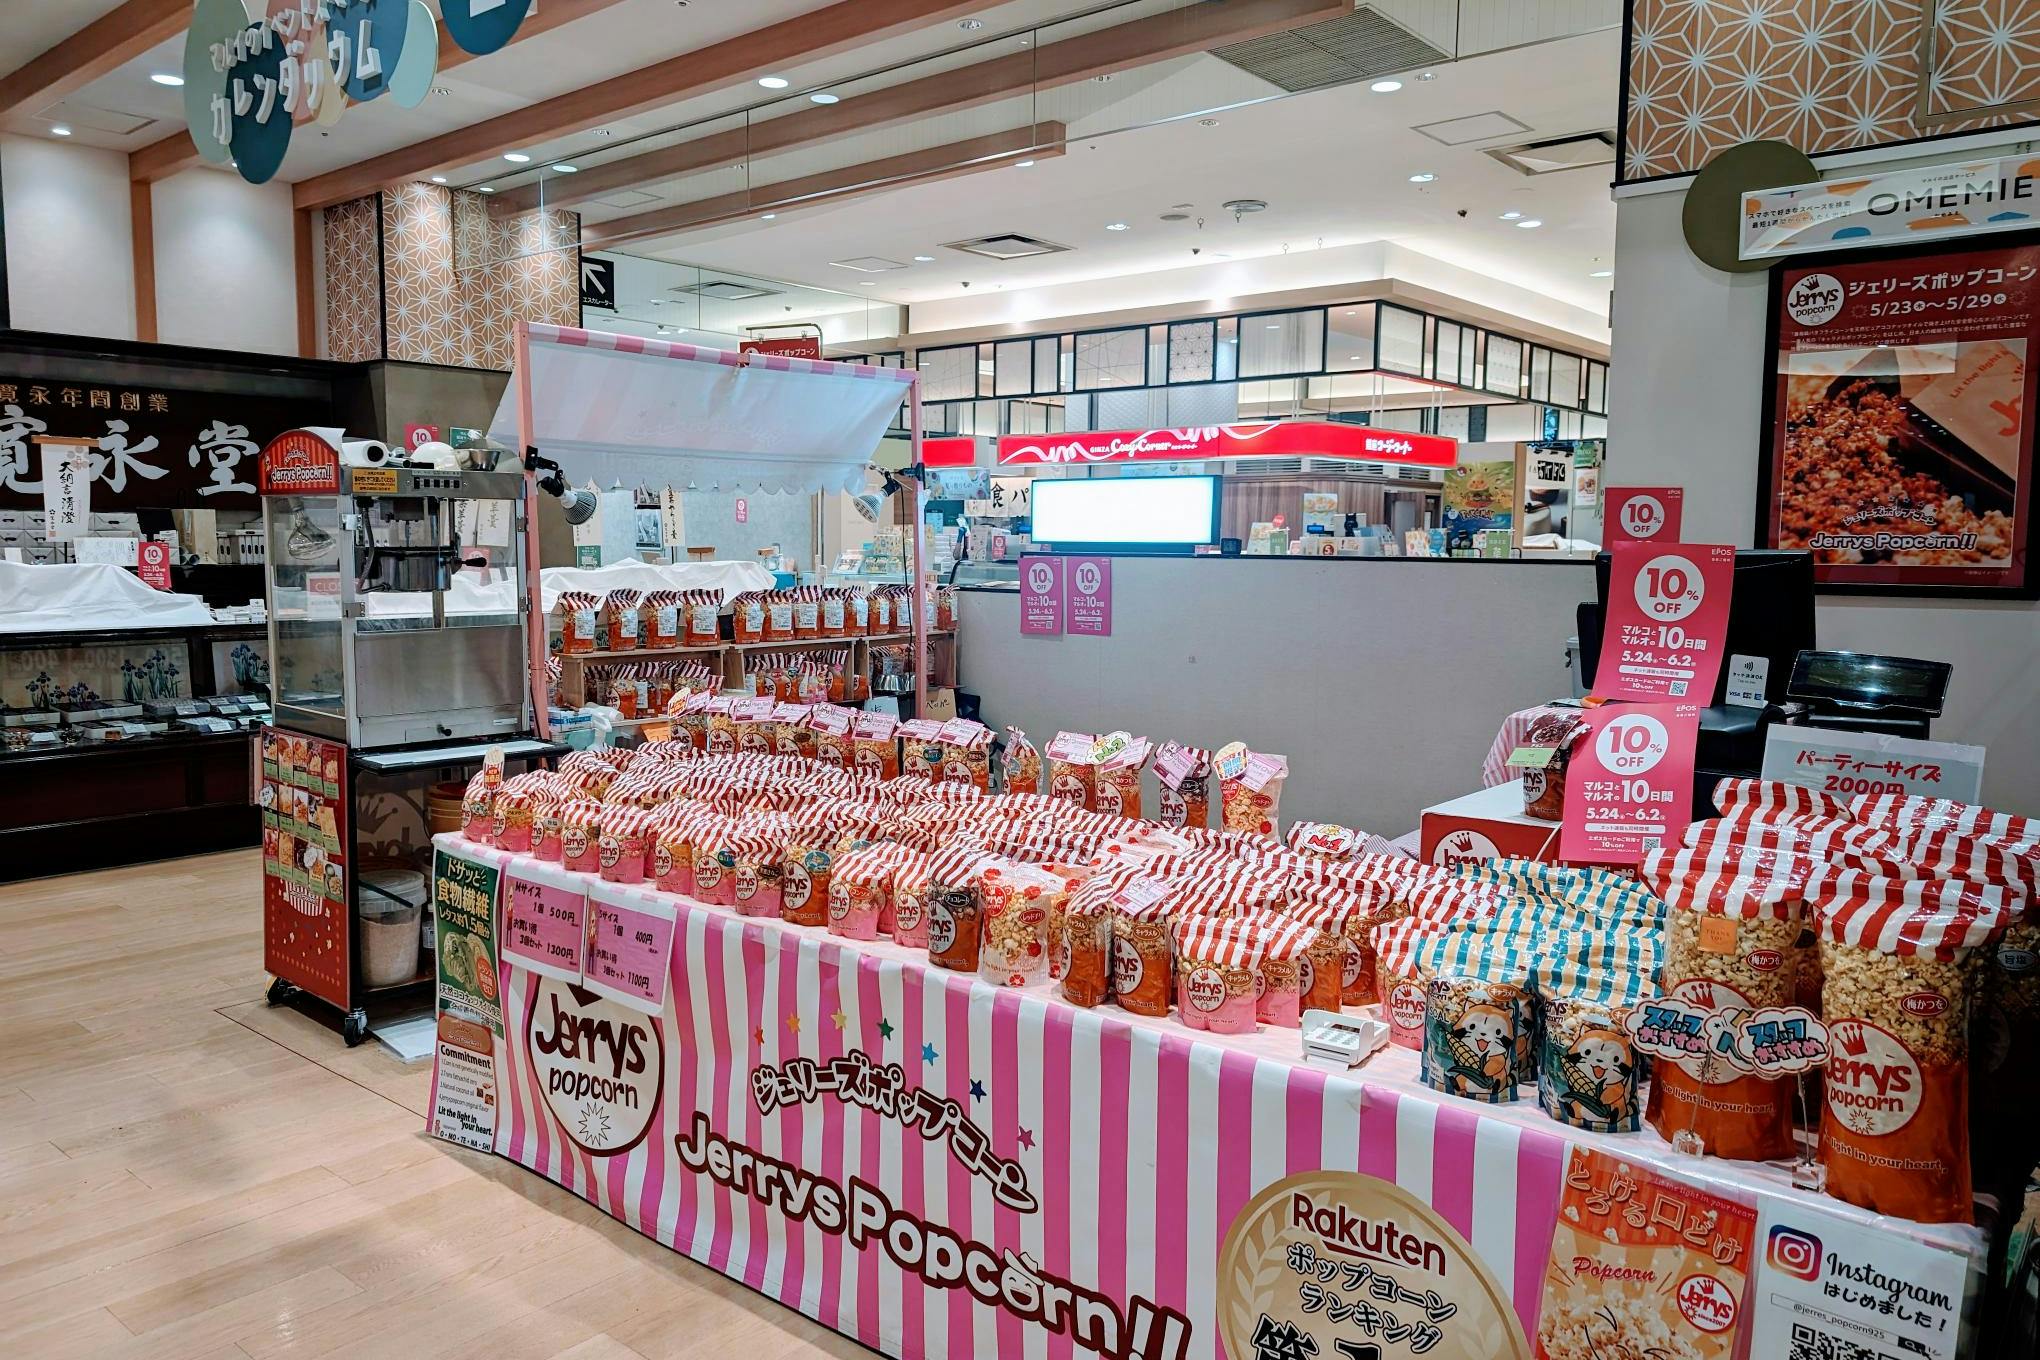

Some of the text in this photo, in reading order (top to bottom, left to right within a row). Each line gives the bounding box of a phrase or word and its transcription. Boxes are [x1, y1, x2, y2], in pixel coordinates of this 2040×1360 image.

[210, 19, 382, 144] カレンダリウム
[1867, 175, 2033, 217] OMEMIE
[1848, 265, 2037, 297] ジェリーズポップコーン
[1789, 287, 1840, 310] Jerrys
[1796, 304, 1835, 318] popcorn
[416, 432, 430, 442] 10
[271, 466, 296, 482] Jerrys
[1627, 503, 1662, 524] 10%
[1633, 525, 1651, 533] OFF
[1810, 532, 1977, 550] Jerrys Popcorn!!
[1711, 548, 1731, 556] EPOS
[1646, 568, 1699, 601] 10%
[1653, 602, 1682, 614] OFF
[1621, 635, 1656, 646] マルオの
[1622, 625, 1656, 636] マルコと
[1621, 650, 1697, 667] 5.24～6.2
[1609, 725, 1663, 753] 10%
[1616, 757, 1644, 767] OFF
[1796, 750, 1942, 783] パーティーサイズ
[1583, 781, 1620, 791] マルコと
[1583, 779, 1674, 804] マルオの 10日間
[1824, 775, 1905, 796] 2000円
[1586, 807, 1666, 821] 5.24～6.2
[447, 857, 481, 888] ドサッと
[437, 877, 491, 921] 食物繊維
[515, 881, 542, 899] Mサイズ
[438, 905, 491, 941] レタス約1.5個分
[533, 902, 575, 923] 1個 500円
[513, 918, 538, 935] お買い得
[613, 924, 653, 946] 1個 400円
[1135, 929, 1159, 937] キャラメル
[519, 934, 574, 960] 3個セット 1300円
[627, 971, 650, 990] 1100円
[1227, 973, 1250, 983] キャラメル
[1267, 964, 1291, 974] キャラメル
[1188, 981, 1222, 994] Jerrys
[1191, 994, 1220, 1002] popcorn
[1392, 995, 1425, 1012] Jerrys
[1429, 1007, 1450, 1023] SCAL
[1905, 998, 1944, 1011] 梅かつを
[1644, 1006, 1705, 1034] スタッフ
[1747, 1019, 1807, 1045] スタッフ
[535, 993, 648, 1079] Jerrys
[1638, 1027, 1706, 1053] おすすめ
[440, 1044, 491, 1070] Commitment
[1753, 1038, 1826, 1064] おすすめ
[549, 1066, 639, 1110] popcorn
[1673, 1085, 1743, 1113] light in your
[1829, 1086, 1904, 1113] popcorn
[438, 1105, 477, 1124] Lit the light in
[461, 1120, 493, 1137] your heart.
[752, 1049, 1038, 1214] ジェリーズポップコーン
[1830, 1139, 1853, 1156] light
[1854, 1149, 1866, 1159] in
[1868, 1154, 1902, 1168] your
[675, 1111, 846, 1235] Jerrys
[1665, 1180, 1679, 1192] the
[1679, 1185, 1700, 1200] light
[1701, 1193, 1710, 1203] in
[1710, 1199, 1731, 1211] your
[1566, 1158, 1743, 1265] とろける口どけ
[1292, 1192, 1447, 1277] Rakuten
[1572, 1256, 1657, 1283] Popcorn
[1826, 1252, 1953, 1312] Instagram
[1286, 1242, 1457, 1324] ポップコーン
[1680, 1284, 1733, 1320] Jerrys
[1823, 1281, 1948, 1332] はじめました！
[1300, 1281, 1443, 1354] ランキング
[1793, 1303, 1885, 1340] @jerres_popcorn925
